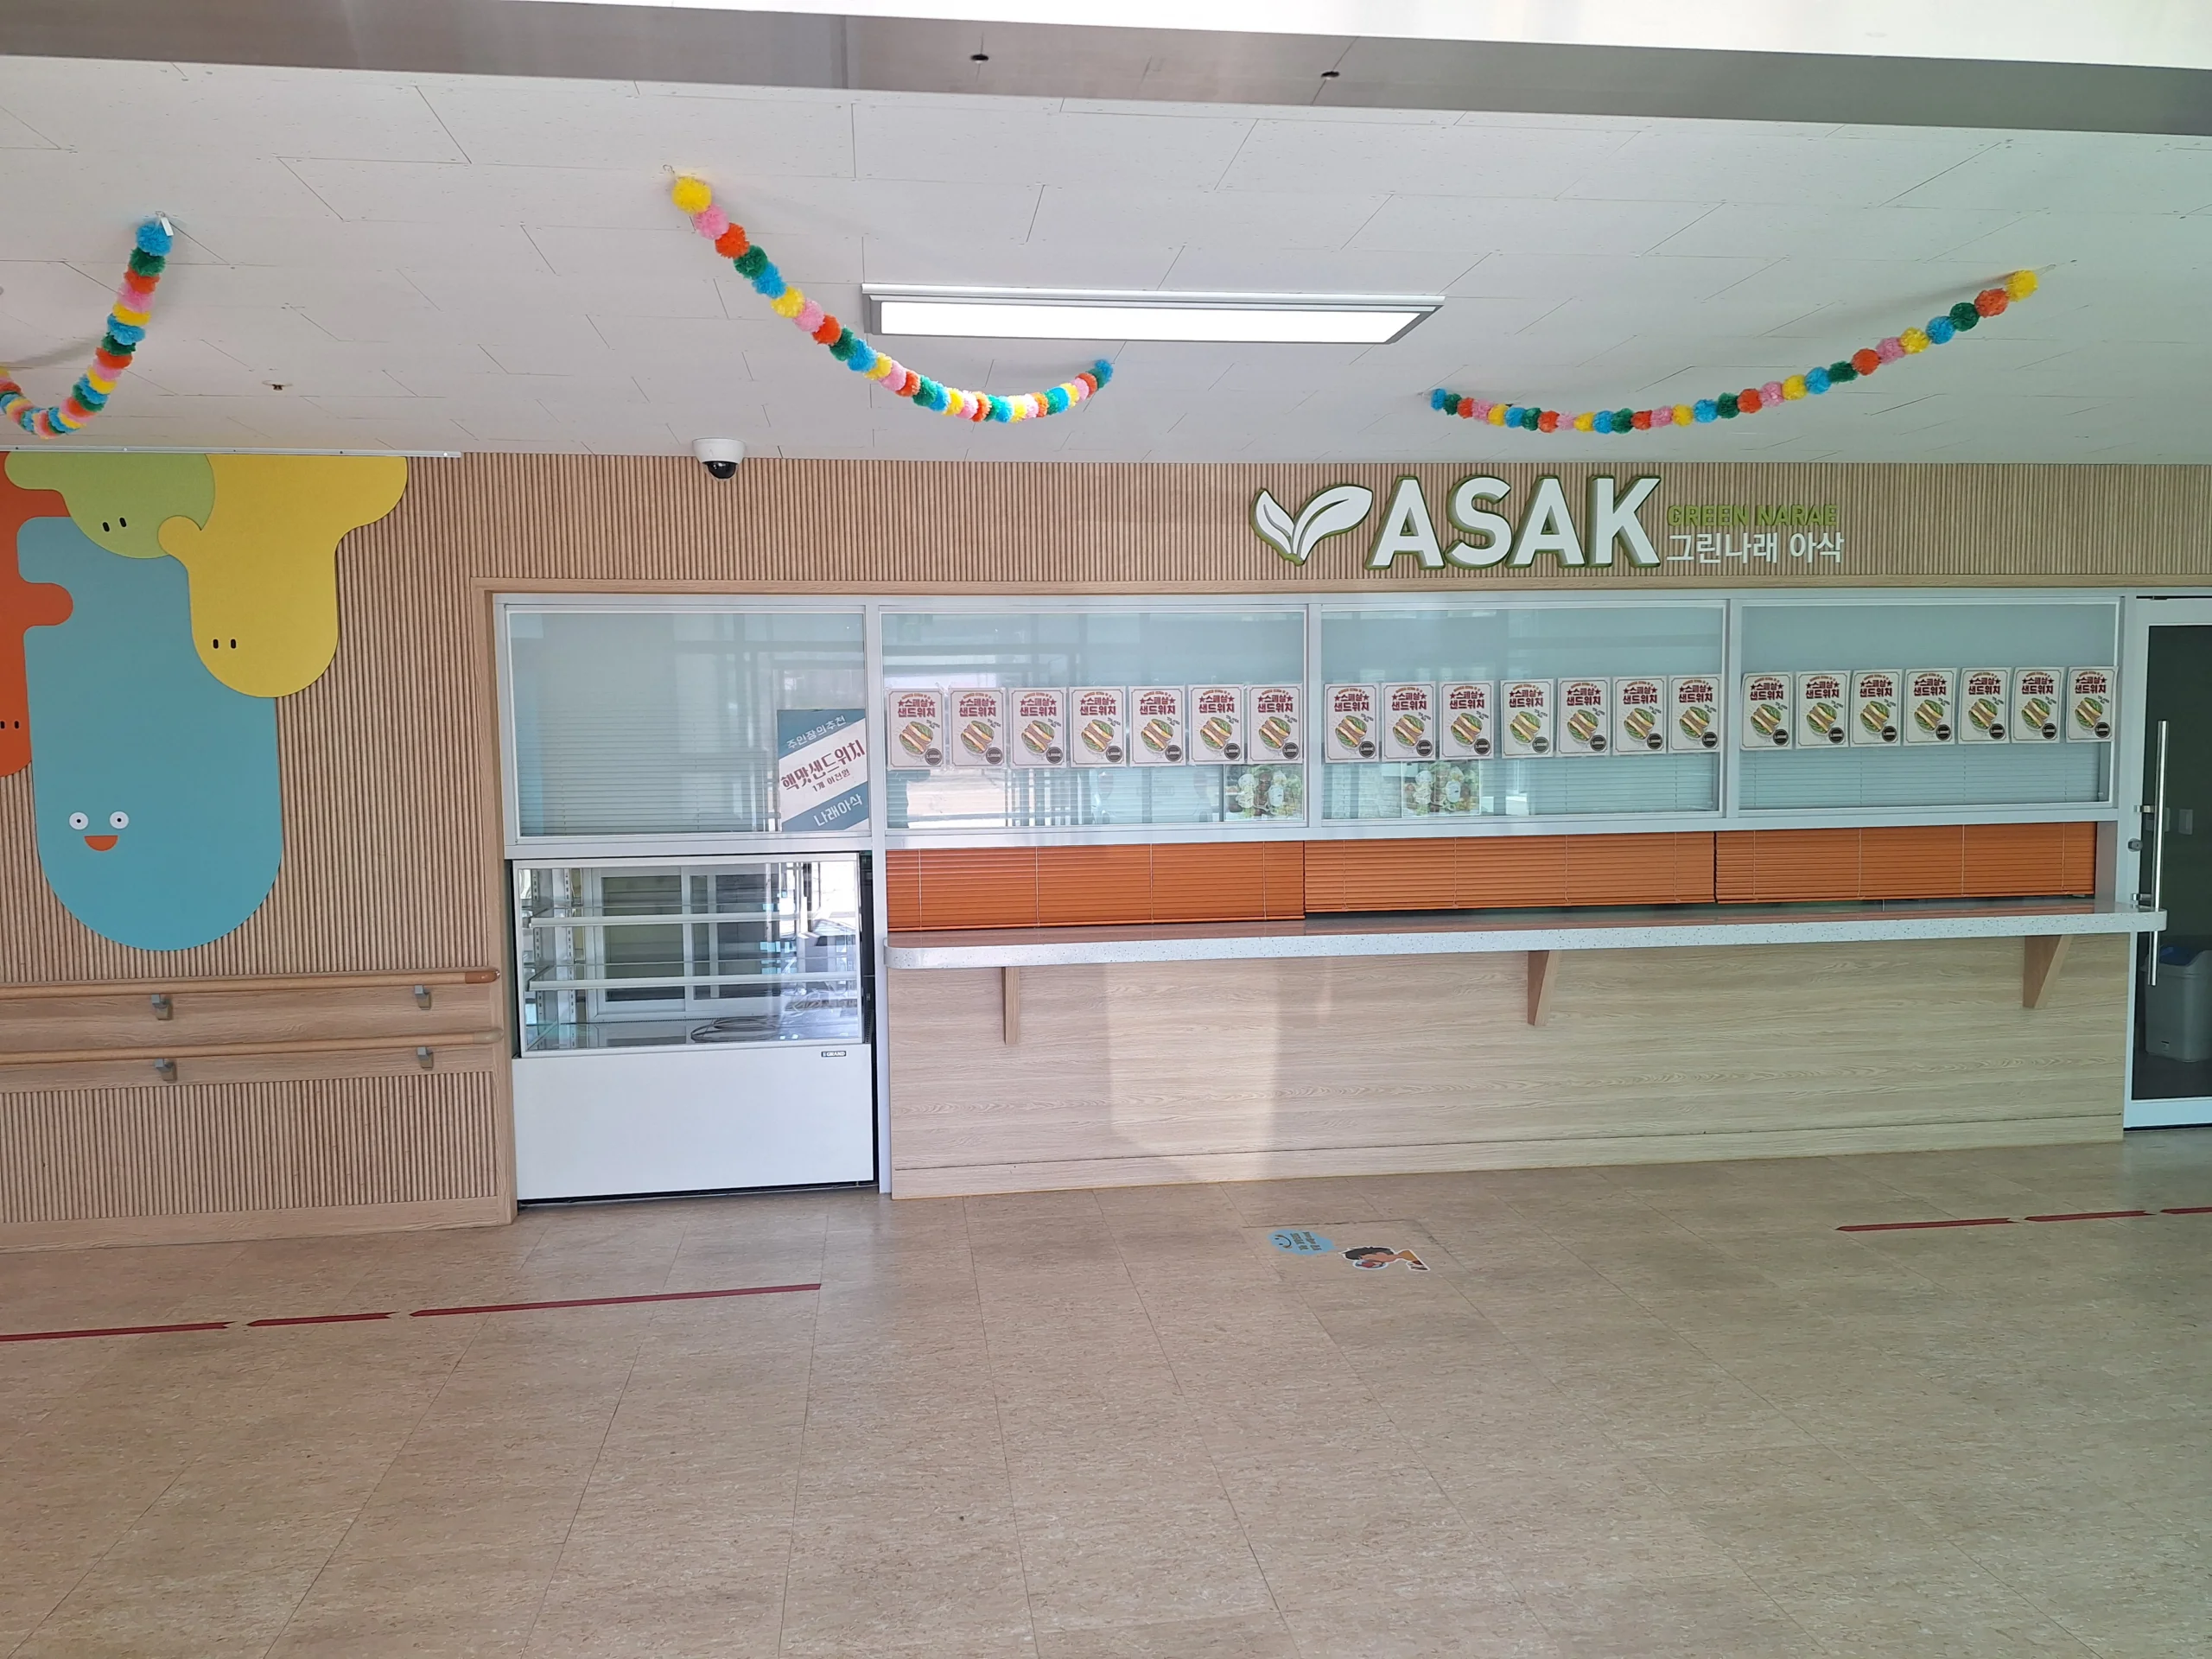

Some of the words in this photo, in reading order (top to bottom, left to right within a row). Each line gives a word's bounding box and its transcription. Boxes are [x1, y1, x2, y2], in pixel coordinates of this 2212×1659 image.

[1667, 505, 1749, 526] GREEN
[1755, 505, 1838, 526] NARAE
[1368, 474, 1661, 569] ASAK
[1667, 532, 1778, 564] 그린나래
[1789, 531, 1845, 563] 아삭
[1860, 687, 1891, 697] 샌드위치
[1914, 686, 1946, 696] 샌드위치
[1968, 685, 2000, 695] 샌드위치
[2022, 684, 2053, 694] 샌드위치
[2075, 683, 2106, 694] 샌드위치
[1624, 694, 1657, 704] 샌드위치
[1679, 692, 1712, 702] 샌드위치
[1750, 690, 1783, 700] 샌드위치
[1806, 689, 1839, 699] 샌드위치
[1392, 700, 1427, 710] 샌드위치
[1450, 699, 1484, 709] 샌드위치
[1510, 697, 1542, 708] 샌드위치
[1567, 696, 1600, 706] 샌드위치
[898, 707, 935, 717] 샌드위치
[959, 706, 995, 716] 샌드위치
[1020, 706, 1056, 716] 샌드위치
[1080, 705, 1116, 715] 샌드위치
[1140, 704, 1175, 715] 샌드위치
[1199, 702, 1234, 713] 샌드위치
[1258, 702, 1293, 713] 샌드위치
[1334, 702, 1369, 712] 샌드위치
[812, 779, 825, 792] 1개
[814, 793, 863, 827] 나래아삭
